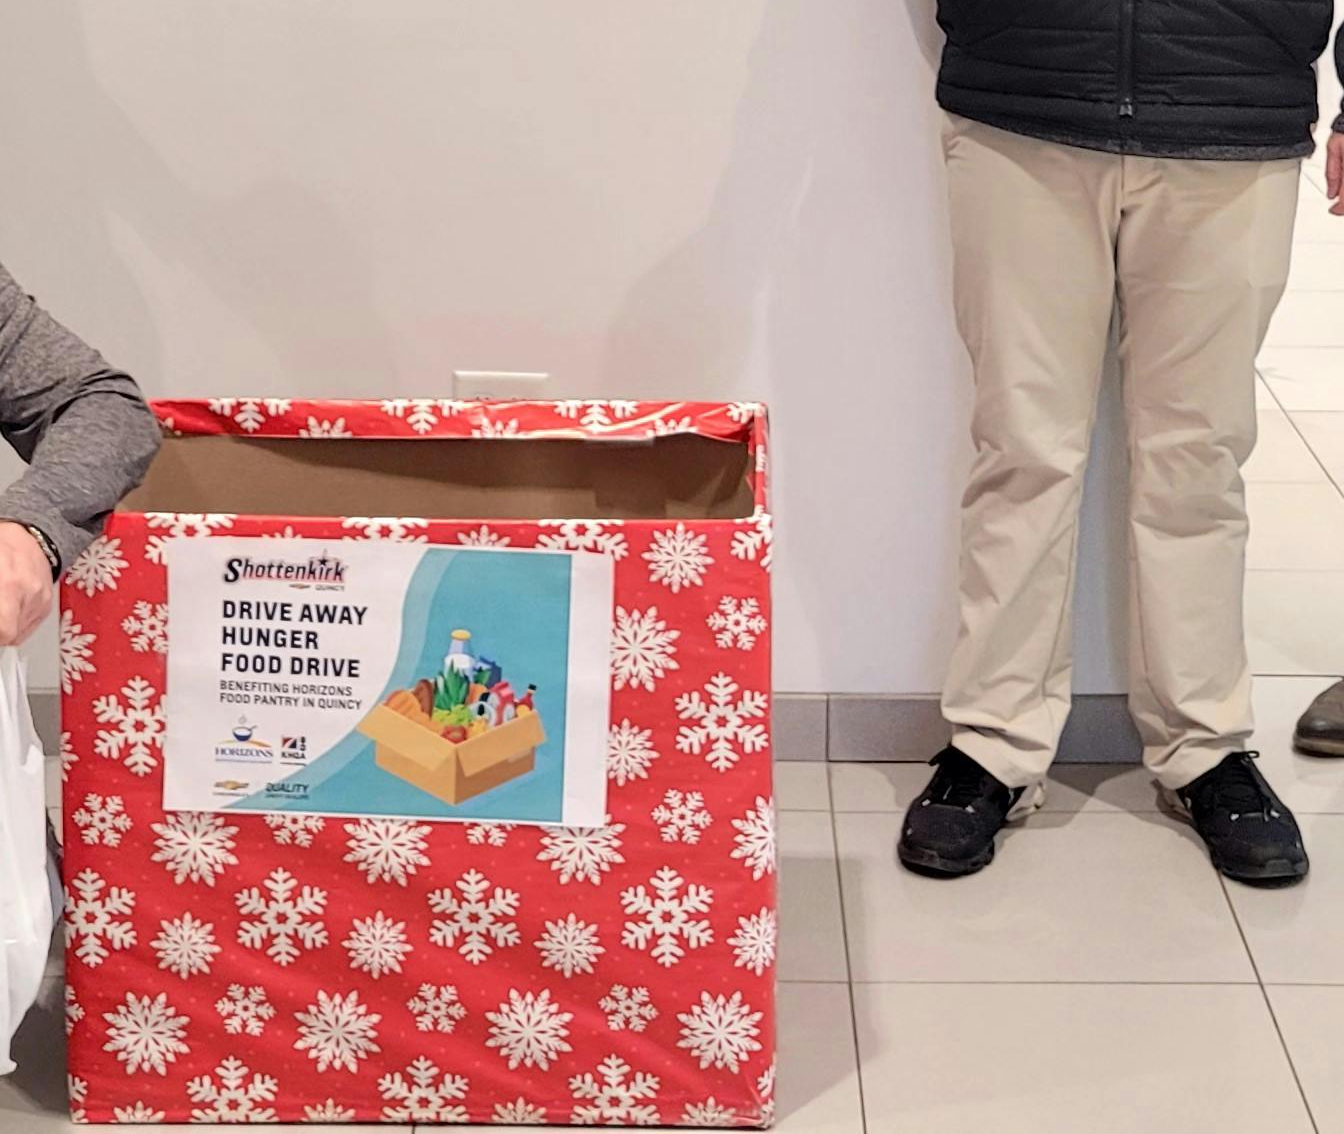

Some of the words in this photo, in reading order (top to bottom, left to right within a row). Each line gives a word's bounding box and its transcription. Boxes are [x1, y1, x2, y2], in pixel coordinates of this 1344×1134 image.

[223, 557, 346, 583] Shottenkirk
[222, 600, 293, 622] DRIVE
[299, 603, 368, 626] AWAY
[221, 626, 320, 650] HUNGER
[221, 652, 283, 674] FOOD
[290, 656, 361, 679] DRIVE
[220, 680, 290, 694] BENEFITING
[292, 683, 353, 697] HORIZONS
[219, 692, 251, 704] FOOD
[254, 694, 300, 708] PANTRY
[302, 697, 316, 708] IN
[318, 698, 362, 711] QUINCY
[214, 746, 274, 758] HORIZONS
